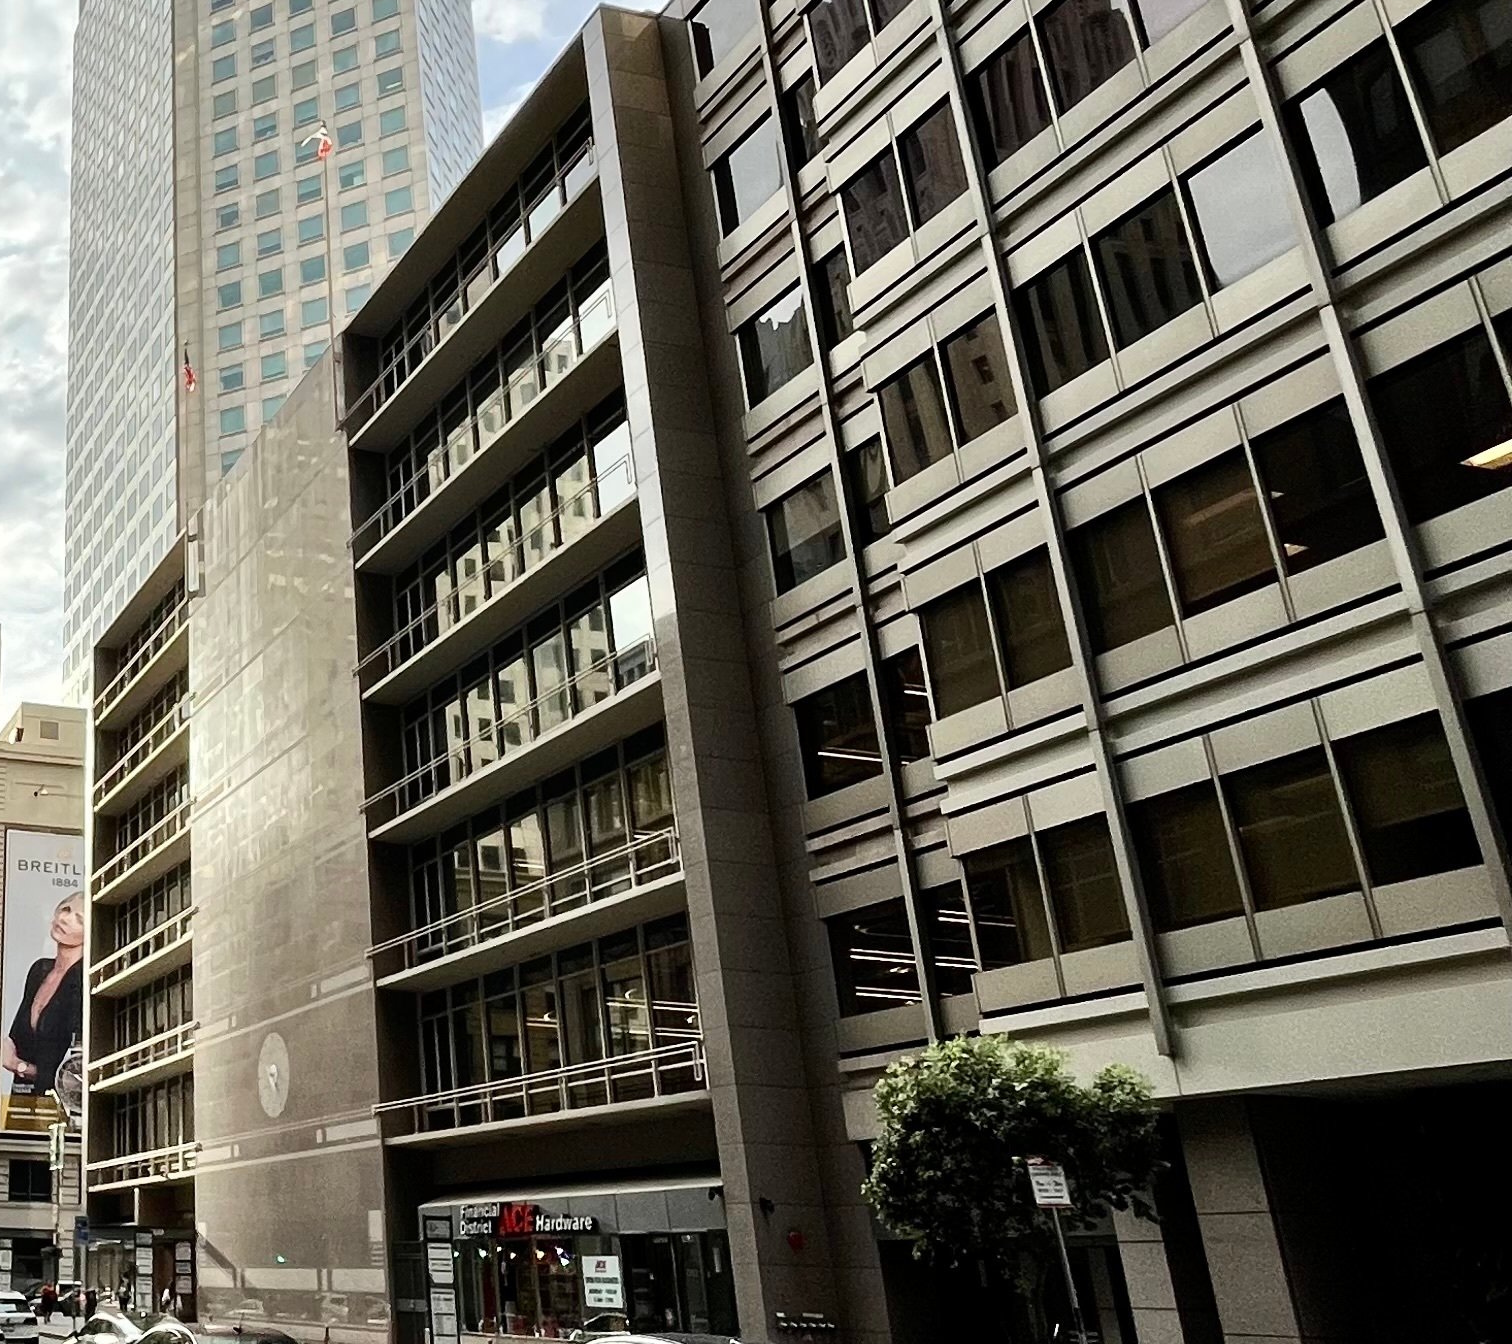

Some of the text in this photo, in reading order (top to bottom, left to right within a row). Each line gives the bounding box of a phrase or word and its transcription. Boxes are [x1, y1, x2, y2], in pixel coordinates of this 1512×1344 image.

[17, 859, 82, 876] BREITL
[51, 877, 79, 888] 1884
[459, 1220, 492, 1235] District
[499, 1205, 592, 1234] ACE Hardware
